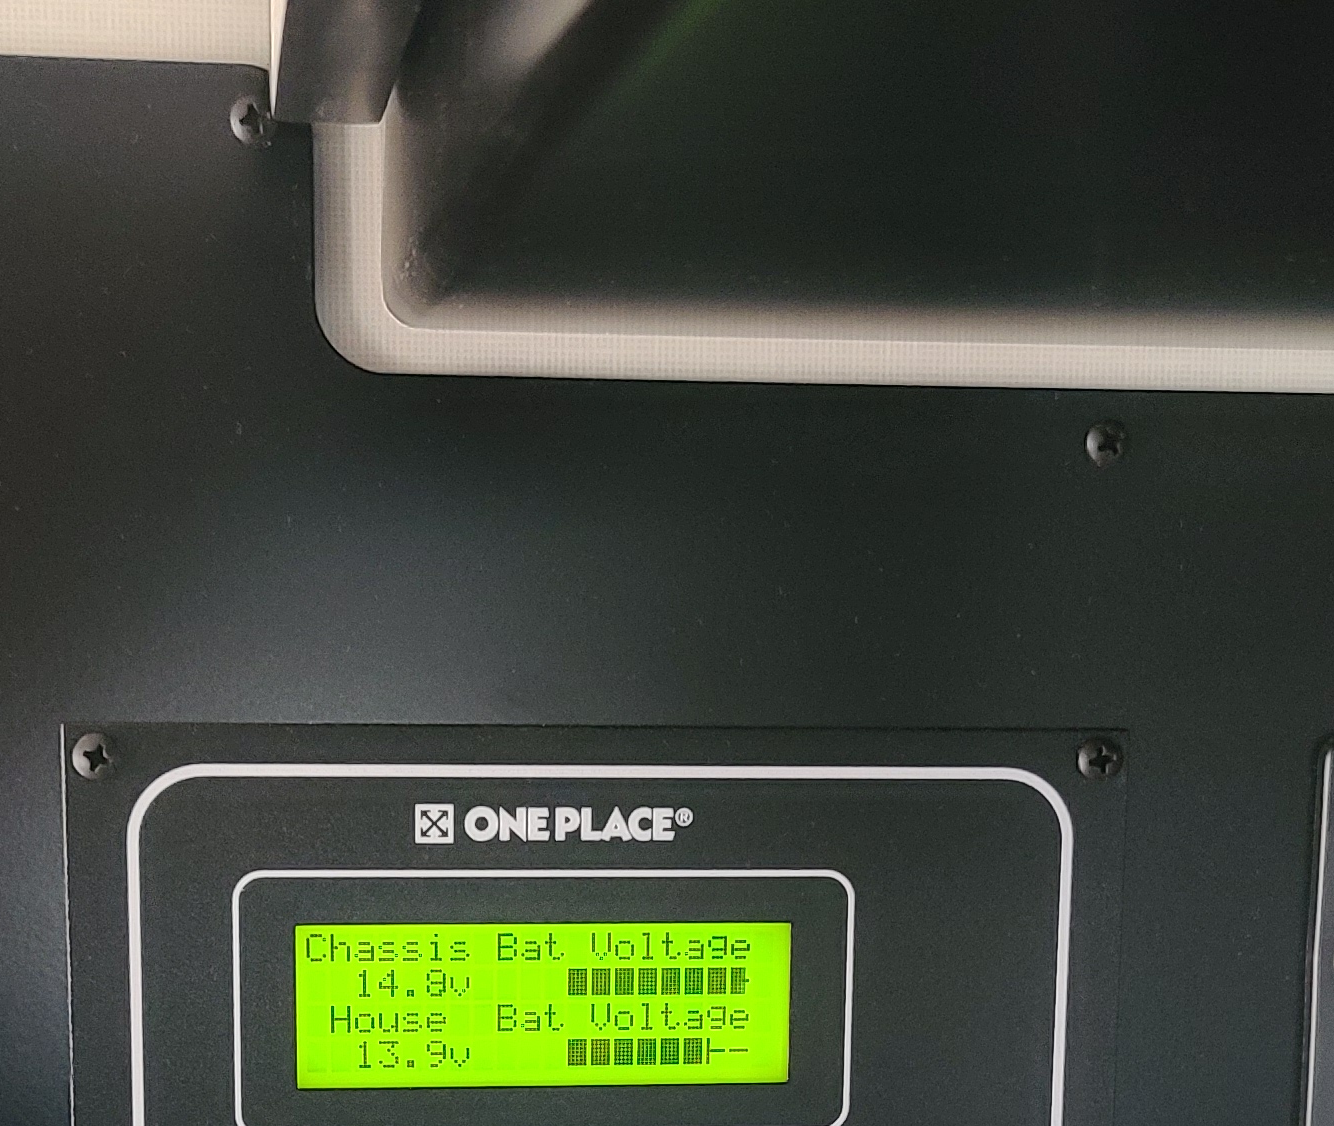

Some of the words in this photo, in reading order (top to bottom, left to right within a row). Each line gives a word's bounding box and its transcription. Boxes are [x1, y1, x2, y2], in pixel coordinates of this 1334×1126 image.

[305, 932, 471, 963] Chassis
[496, 932, 566, 962] Bat
[590, 932, 752, 962] Voltage
[330, 1005, 449, 1034] House
[496, 1003, 566, 1032] Bat
[589, 1003, 751, 1033] Voltage
[358, 1040, 471, 1069] 13.9v
